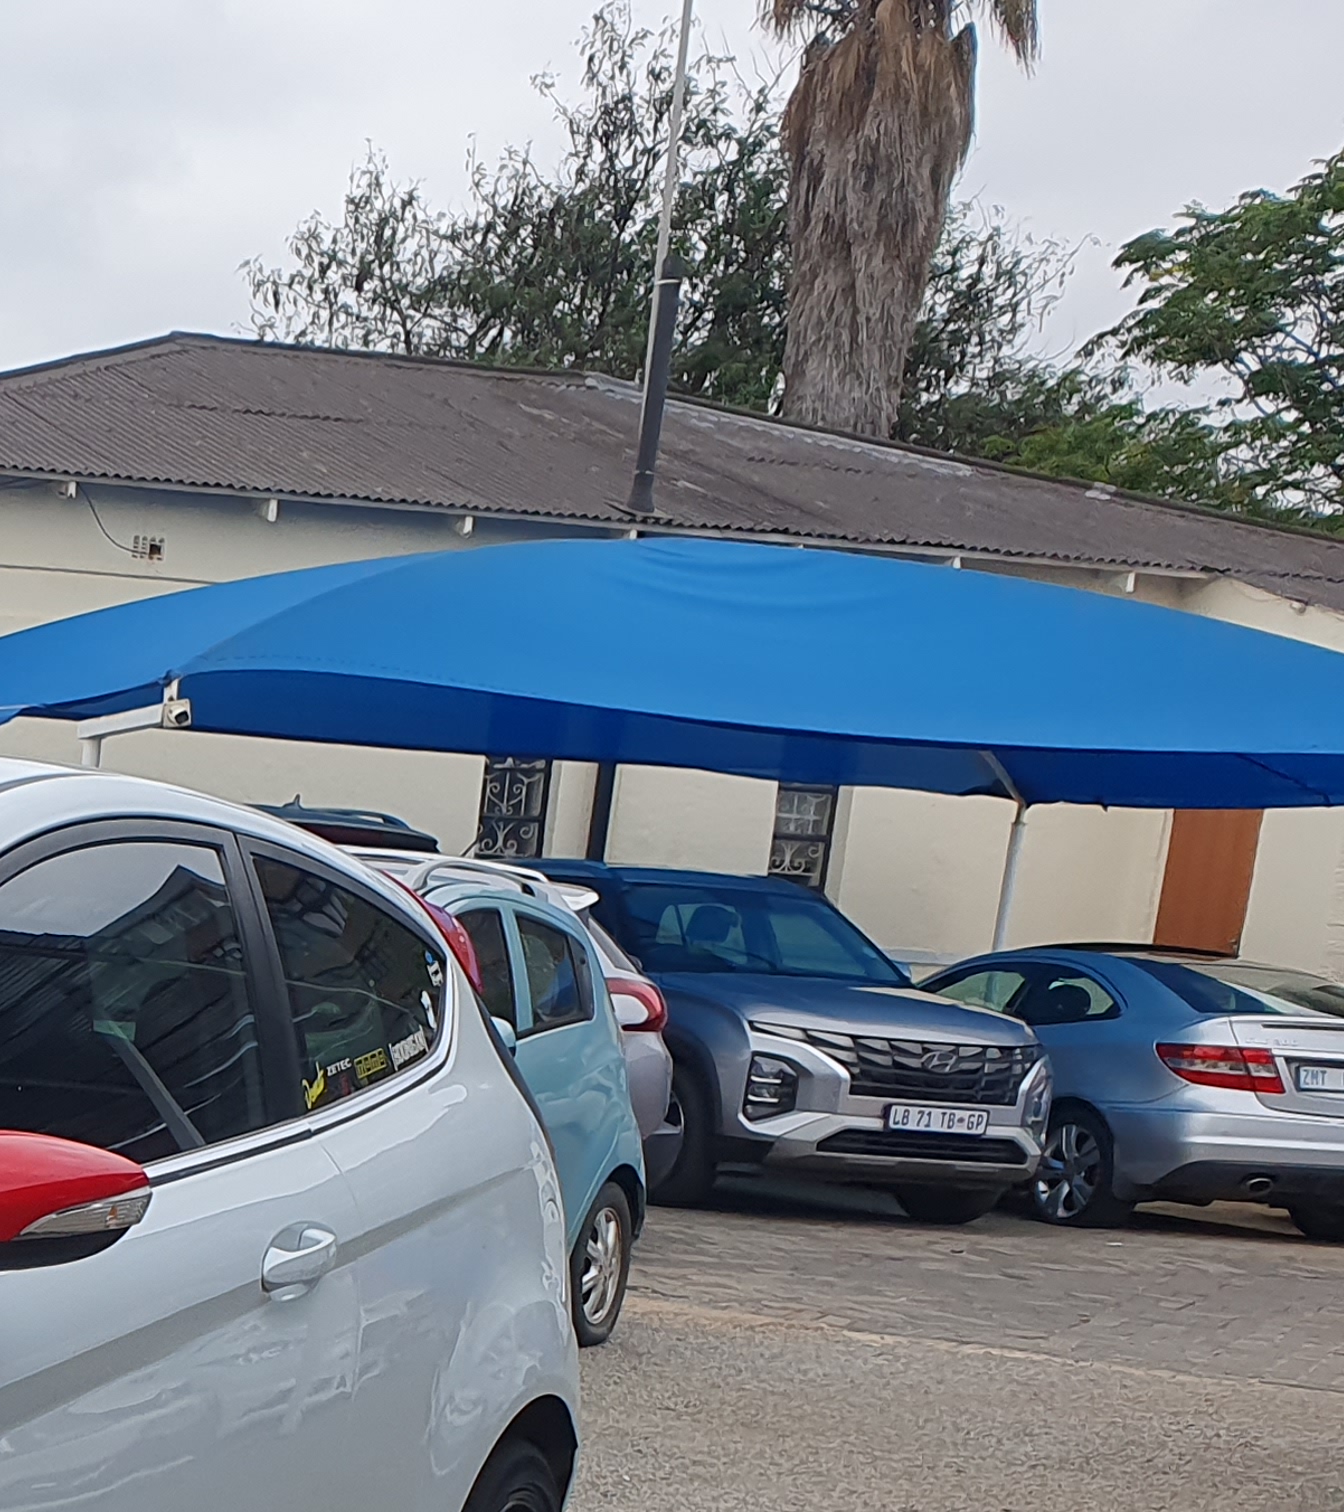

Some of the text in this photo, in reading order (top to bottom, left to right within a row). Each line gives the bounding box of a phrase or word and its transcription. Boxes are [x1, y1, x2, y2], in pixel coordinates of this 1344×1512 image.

[326, 1057, 352, 1077] ZETEC
[892, 1108, 984, 1130] LB 71 TB GP
